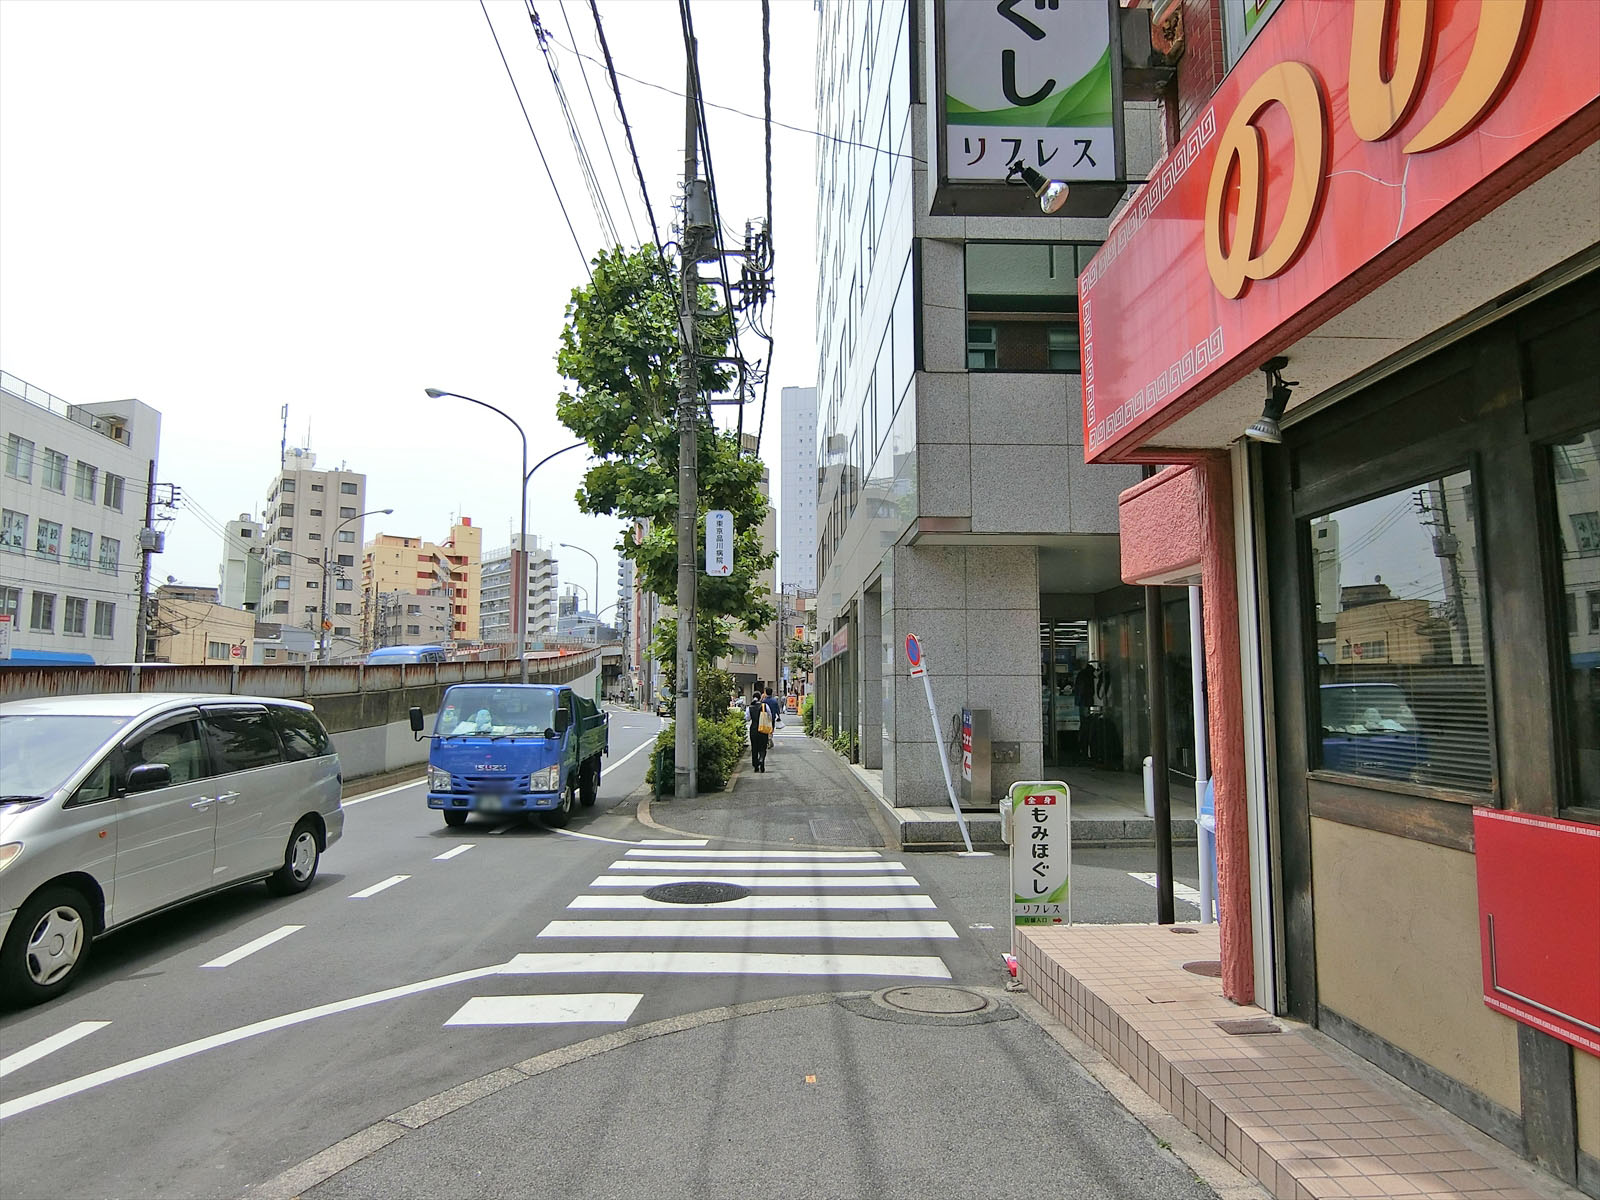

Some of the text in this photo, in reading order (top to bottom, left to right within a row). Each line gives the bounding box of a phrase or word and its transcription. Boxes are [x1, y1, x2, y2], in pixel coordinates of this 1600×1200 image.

[997, 0, 1059, 106] ぐし
[964, 137, 1097, 168] リフレス
[715, 520, 724, 564] 東京品川病院
[475, 764, 507, 772] ISUZU
[1027, 796, 1052, 805] 全身
[1031, 807, 1049, 894] もみほぐし
[1023, 904, 1061, 914] リフレス
